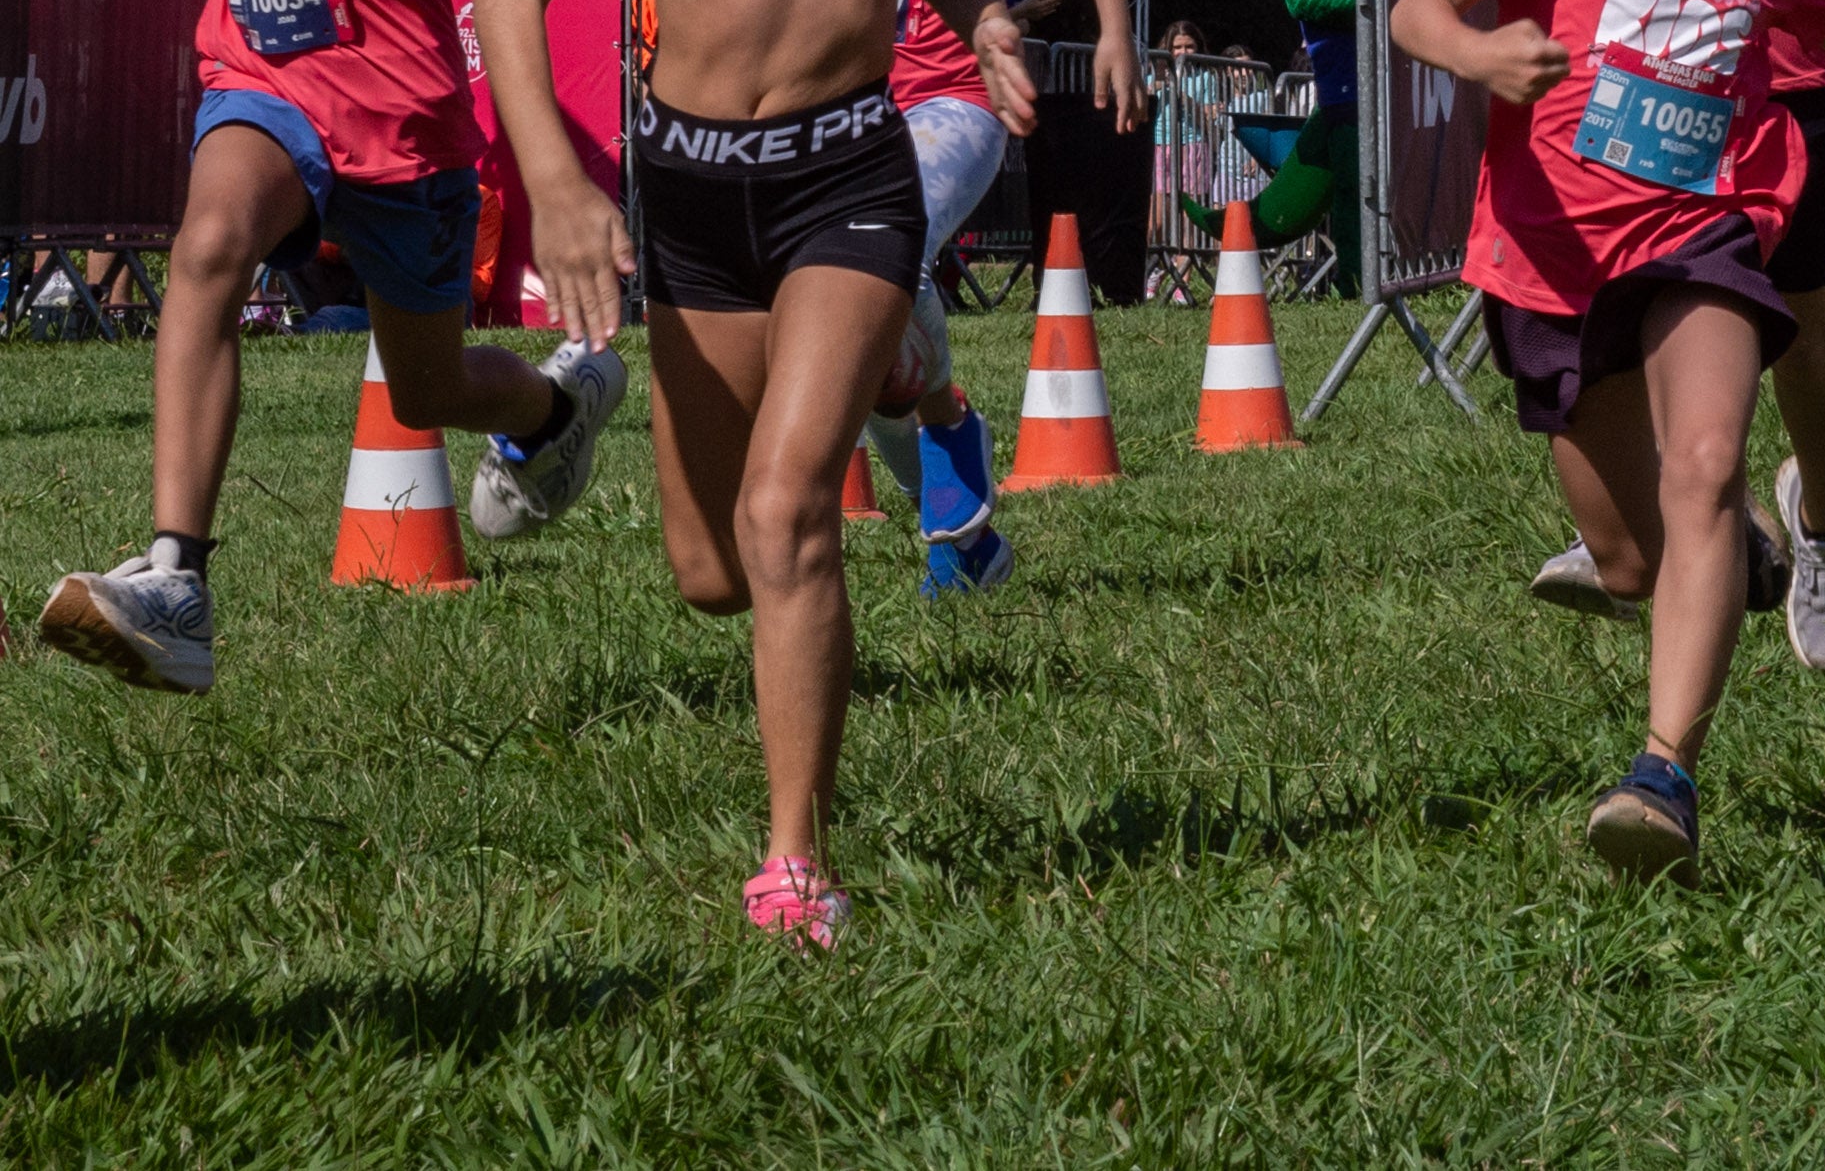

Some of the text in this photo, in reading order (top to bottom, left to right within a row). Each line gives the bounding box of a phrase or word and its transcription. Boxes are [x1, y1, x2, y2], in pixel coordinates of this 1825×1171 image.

[1599, 67, 1630, 85] 250m
[1642, 55, 1692, 80] ATHENAS
[1584, 111, 1614, 131] 2017
[1641, 96, 1726, 144] 10055
[662, 120, 802, 165] NIKE
